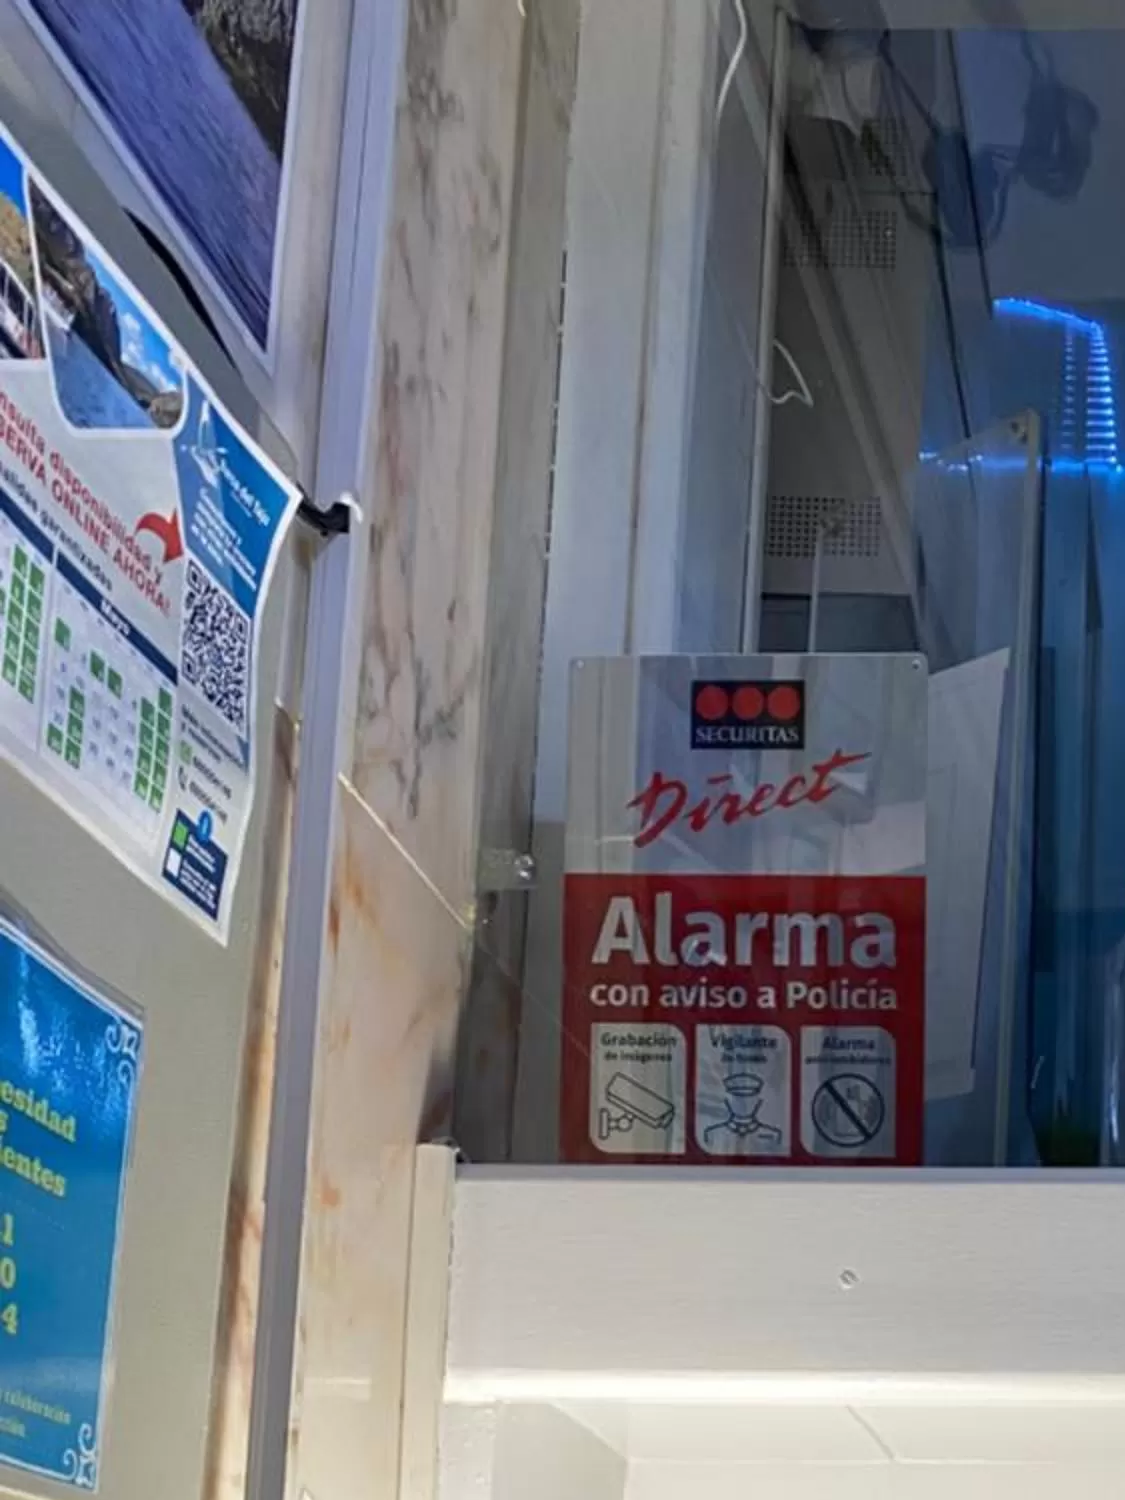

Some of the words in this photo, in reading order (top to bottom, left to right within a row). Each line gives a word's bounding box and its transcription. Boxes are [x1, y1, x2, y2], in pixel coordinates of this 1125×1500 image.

[52, 478, 110, 553] ONLINE
[695, 726, 800, 744] SECURITAS
[628, 749, 872, 848] Direct
[591, 891, 897, 968] Alarma
[589, 983, 649, 1007] con
[659, 977, 748, 1008] aviso
[757, 985, 776, 1009] a
[786, 977, 898, 1010] Policía
[600, 1031, 677, 1047] Grabación
[709, 1032, 778, 1050] Vigilante
[822, 1035, 875, 1050] Alarma
